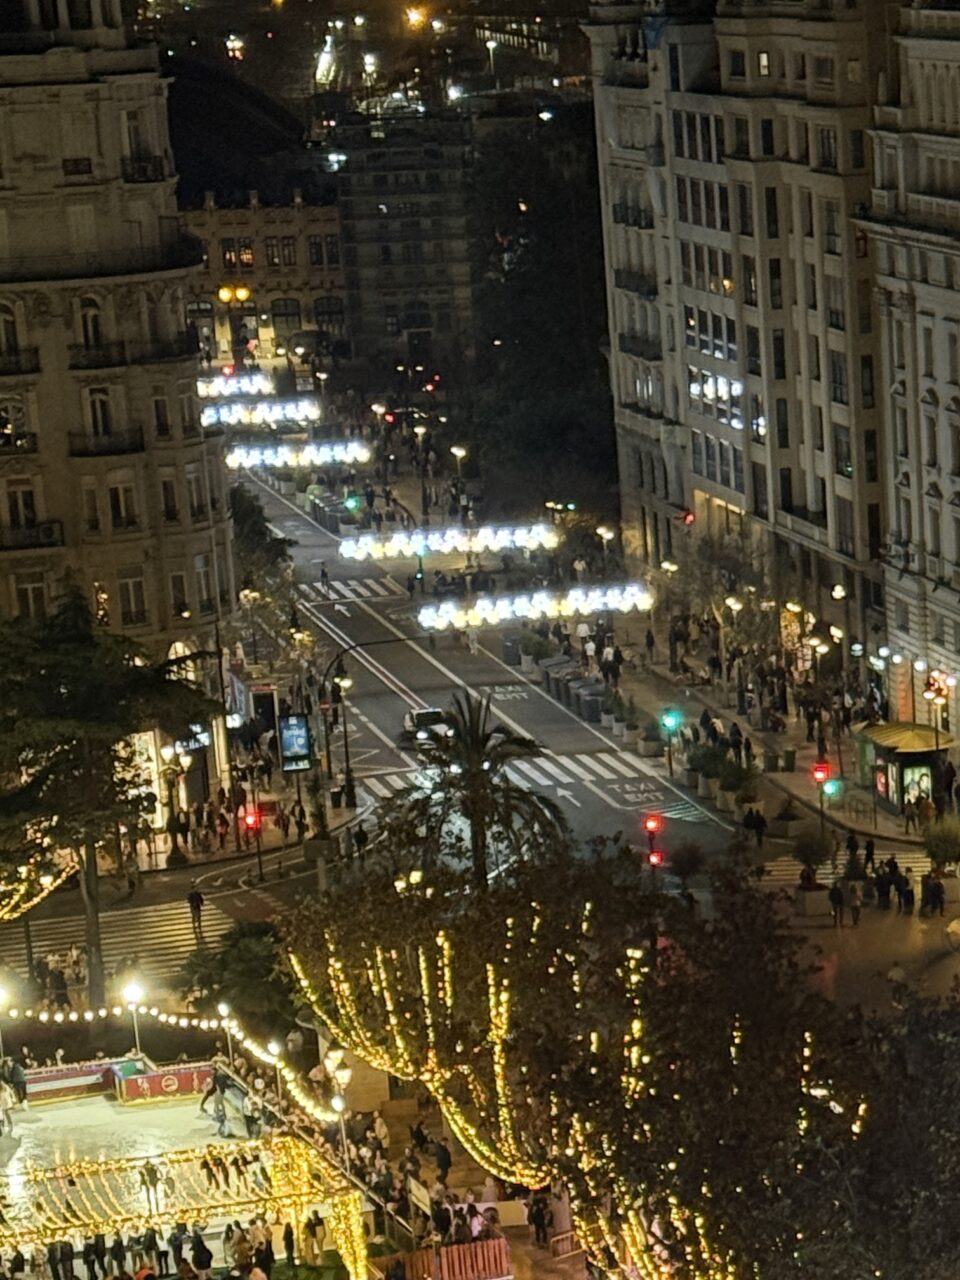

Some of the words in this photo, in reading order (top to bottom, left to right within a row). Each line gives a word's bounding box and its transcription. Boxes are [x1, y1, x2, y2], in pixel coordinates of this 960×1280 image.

[479, 685, 523, 694] TAXI
[493, 692, 529, 701] EMT
[606, 782, 656, 792] TAXI
[623, 791, 665, 802] EMT
